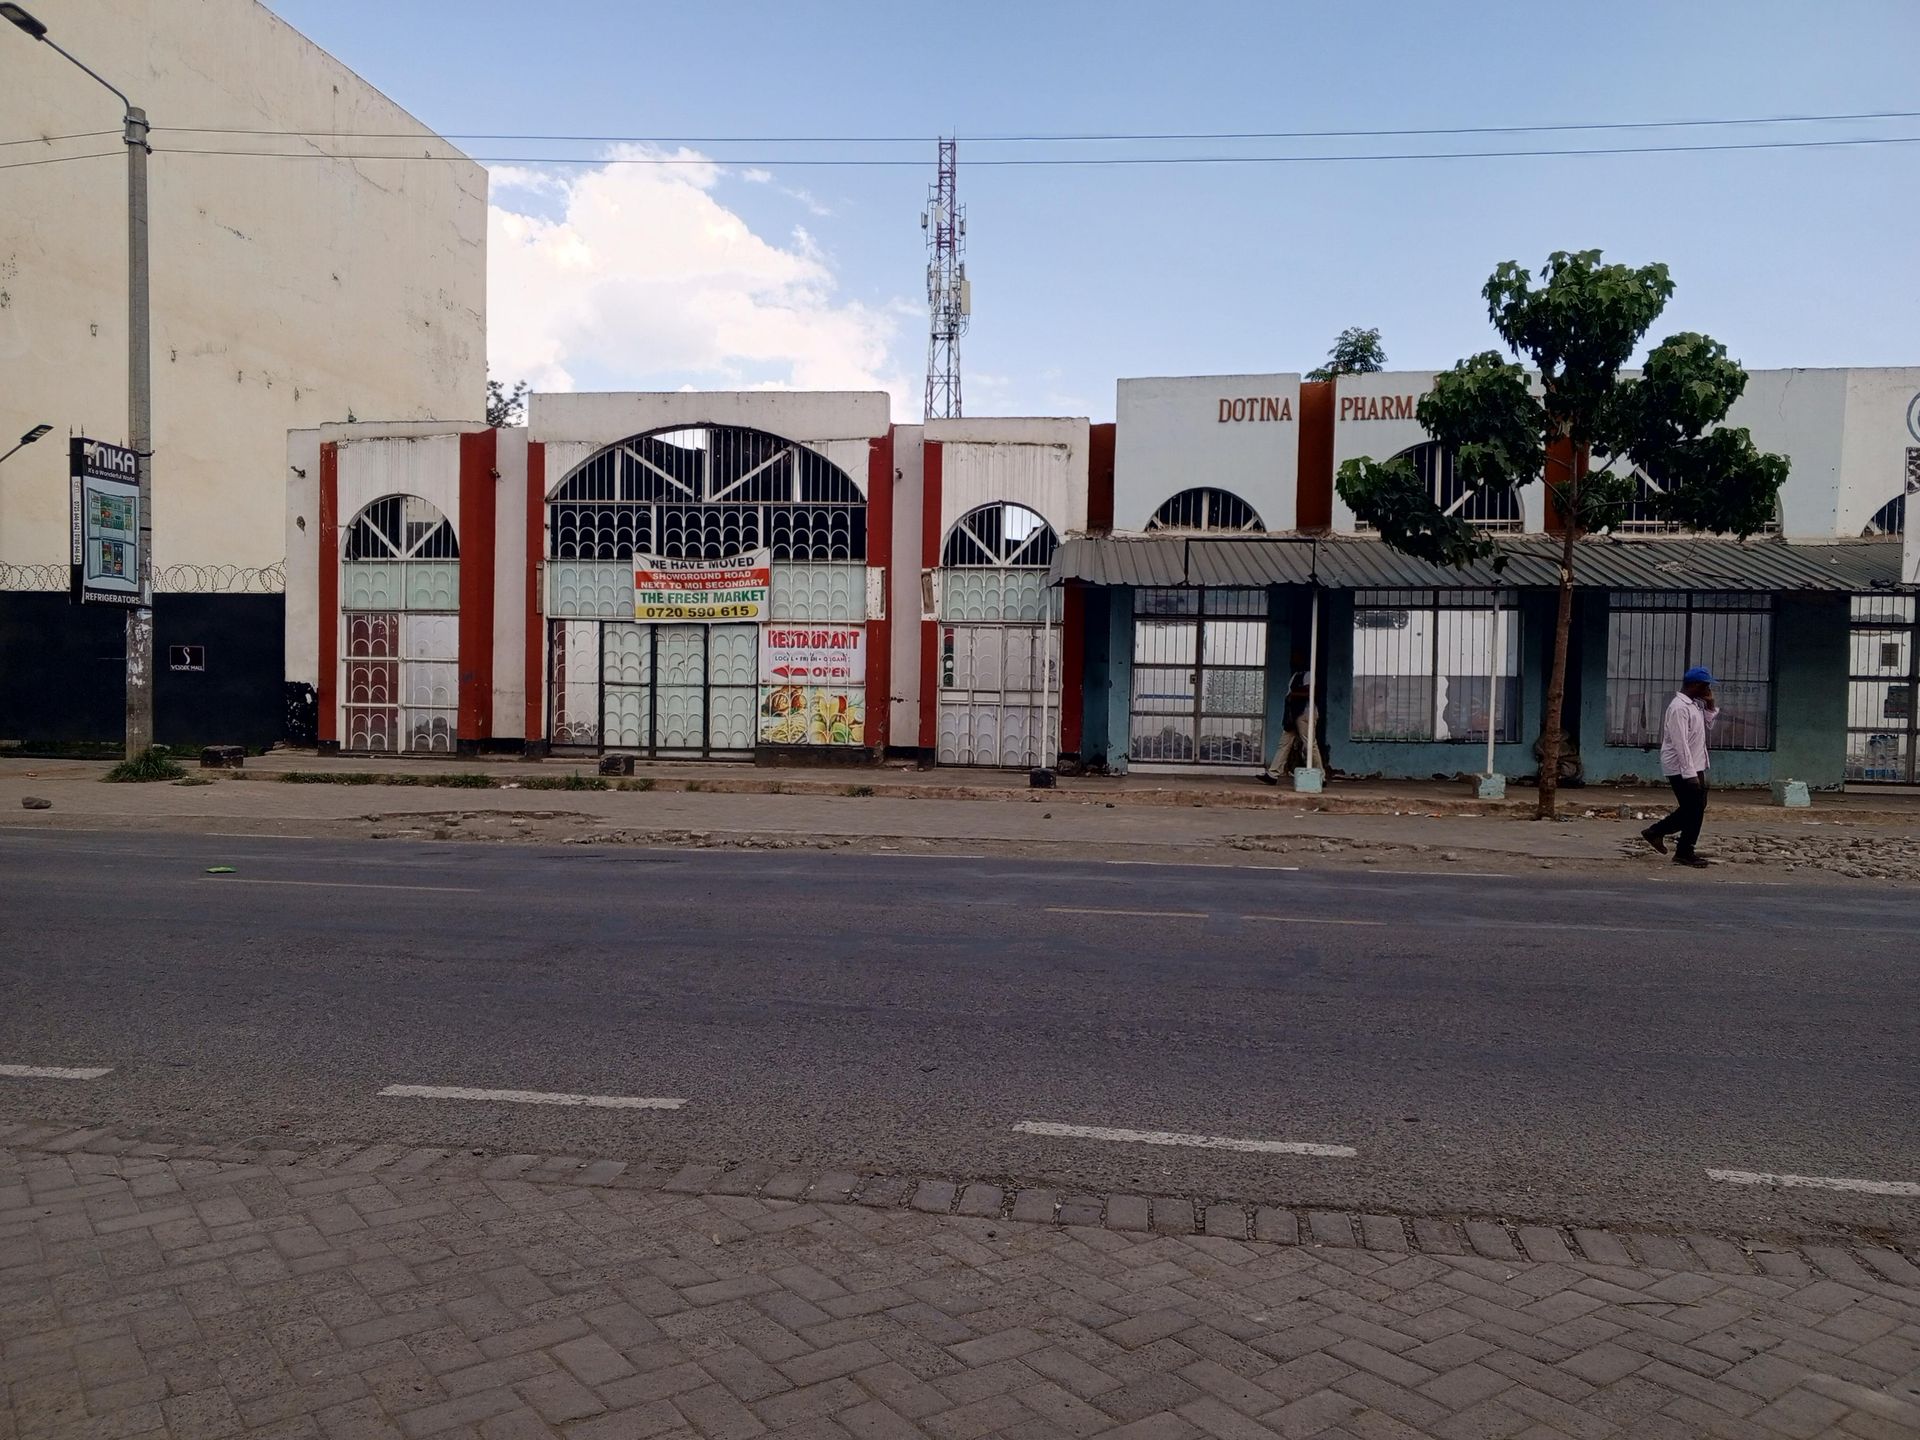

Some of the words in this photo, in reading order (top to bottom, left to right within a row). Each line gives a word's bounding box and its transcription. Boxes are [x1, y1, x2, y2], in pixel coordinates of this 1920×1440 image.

[1218, 397, 1292, 423] DOTINA
[1340, 395, 1417, 421] PHARM
[99, 470, 122, 479] Wonderful
[649, 560, 667, 570] WE
[671, 561, 704, 570] HAVE
[708, 557, 755, 569] MOVED
[652, 571, 722, 581] SHOWGROUND
[724, 570, 751, 579] ROAD
[640, 581, 666, 589] NEXT
[685, 581, 702, 590] MOI
[705, 579, 764, 589] SECONDARY
[85, 591, 141, 605] REFRIGERATORS
[641, 592, 665, 604] THE
[667, 592, 709, 604] FRESH
[713, 590, 766, 603] MARKET
[646, 607, 683, 618] 0720
[688, 607, 716, 617] 590
[720, 605, 750, 616] 615
[768, 630, 860, 649] RESTAURANT
[812, 667, 851, 678] OPEN
